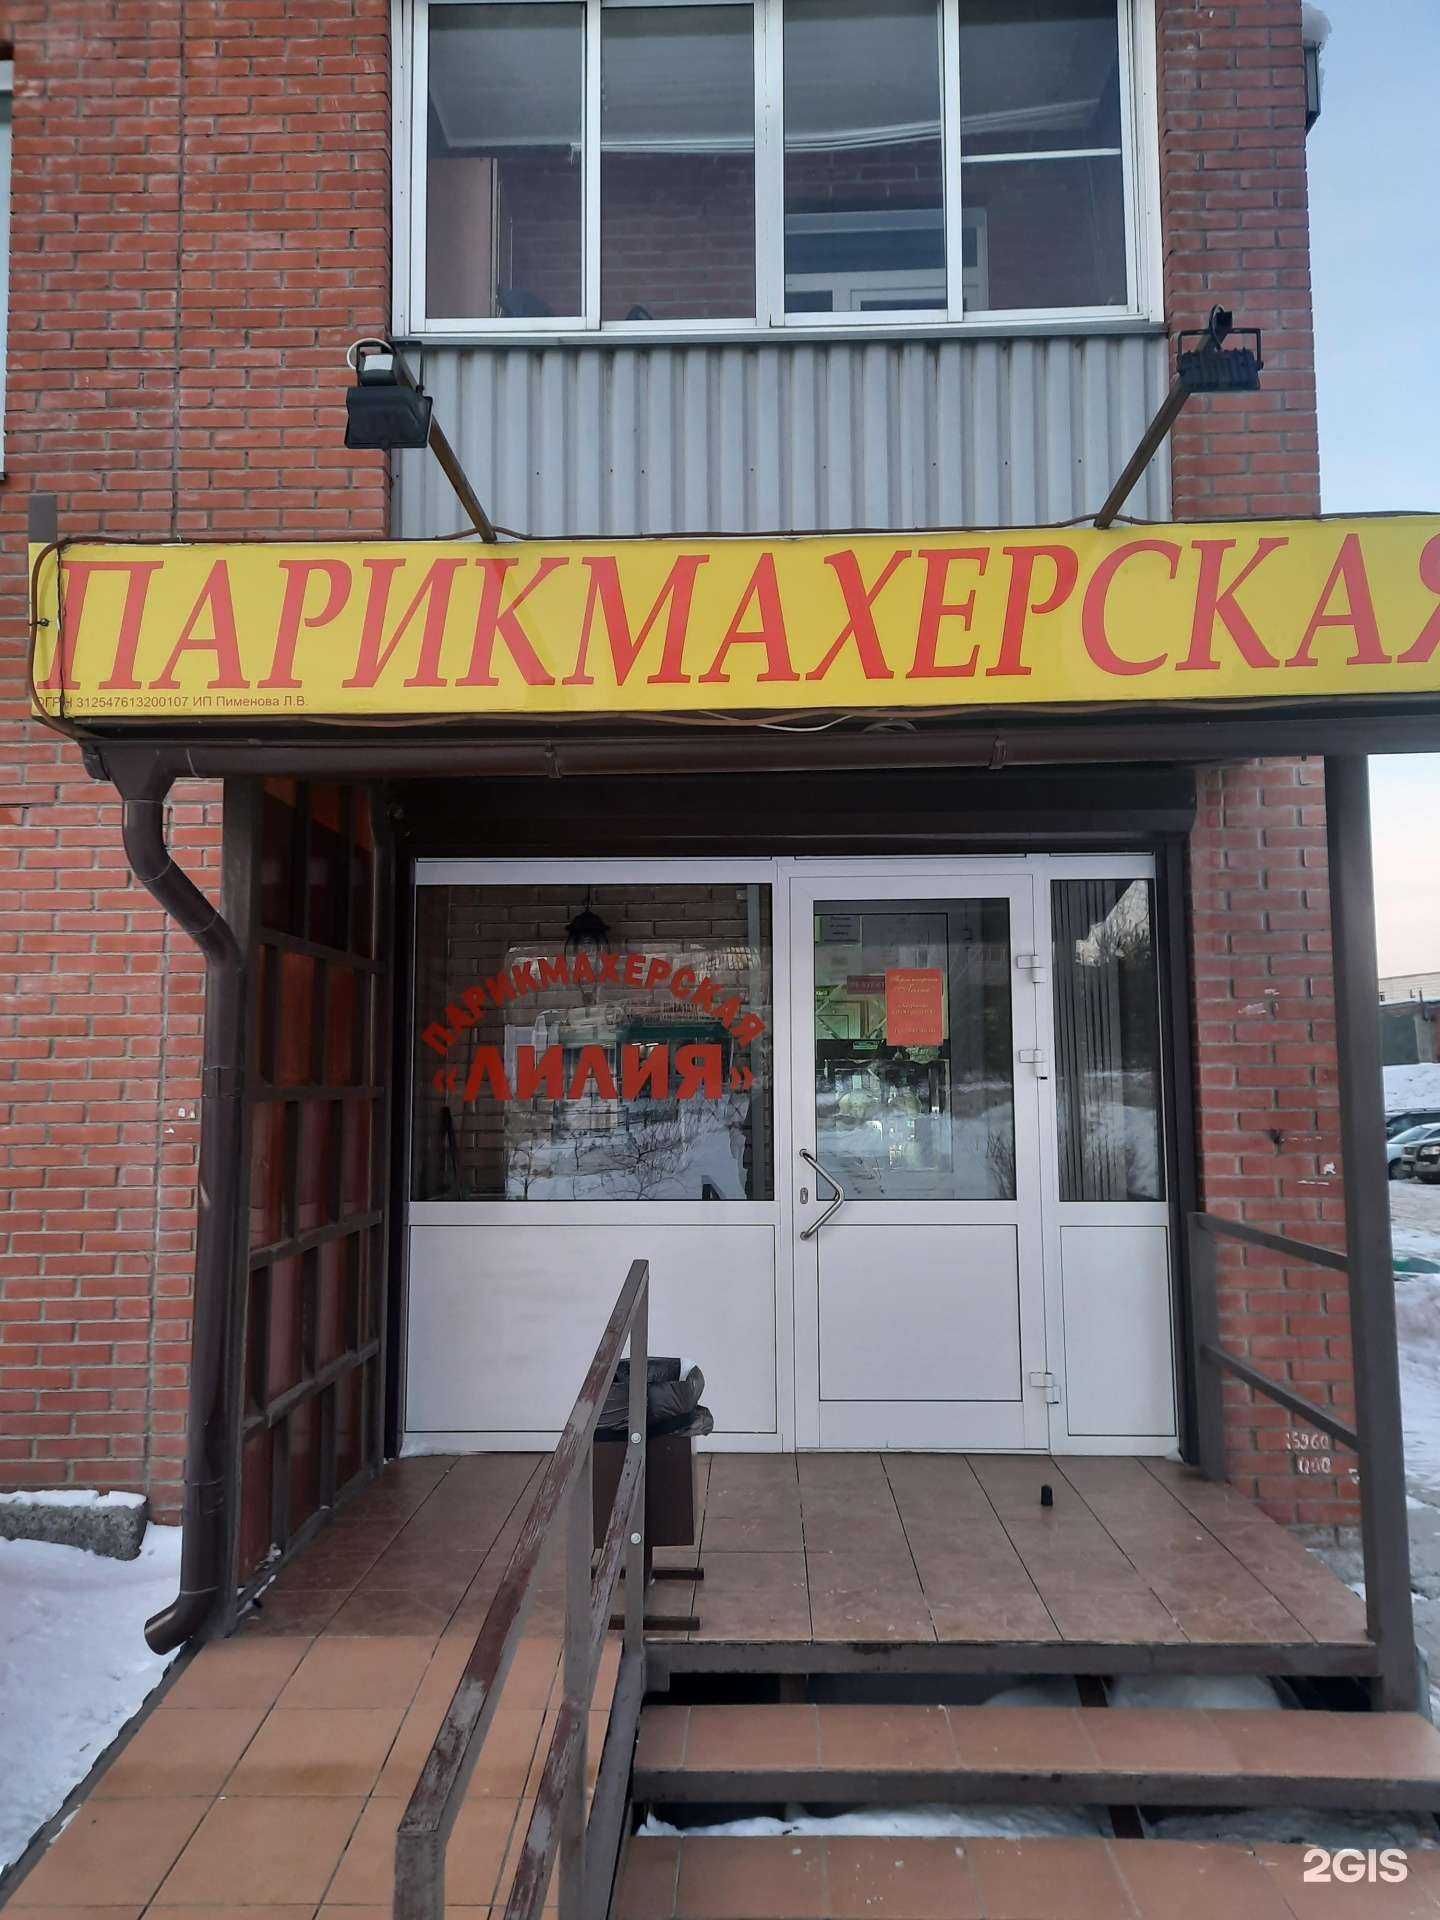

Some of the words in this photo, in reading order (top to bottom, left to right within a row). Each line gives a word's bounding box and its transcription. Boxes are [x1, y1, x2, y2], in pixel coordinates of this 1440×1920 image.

[193, 695, 212, 706] ИП
[216, 695, 280, 707] Пименова
[421, 952, 766, 1055] ПАРИКМАХЕРСКАЯ
